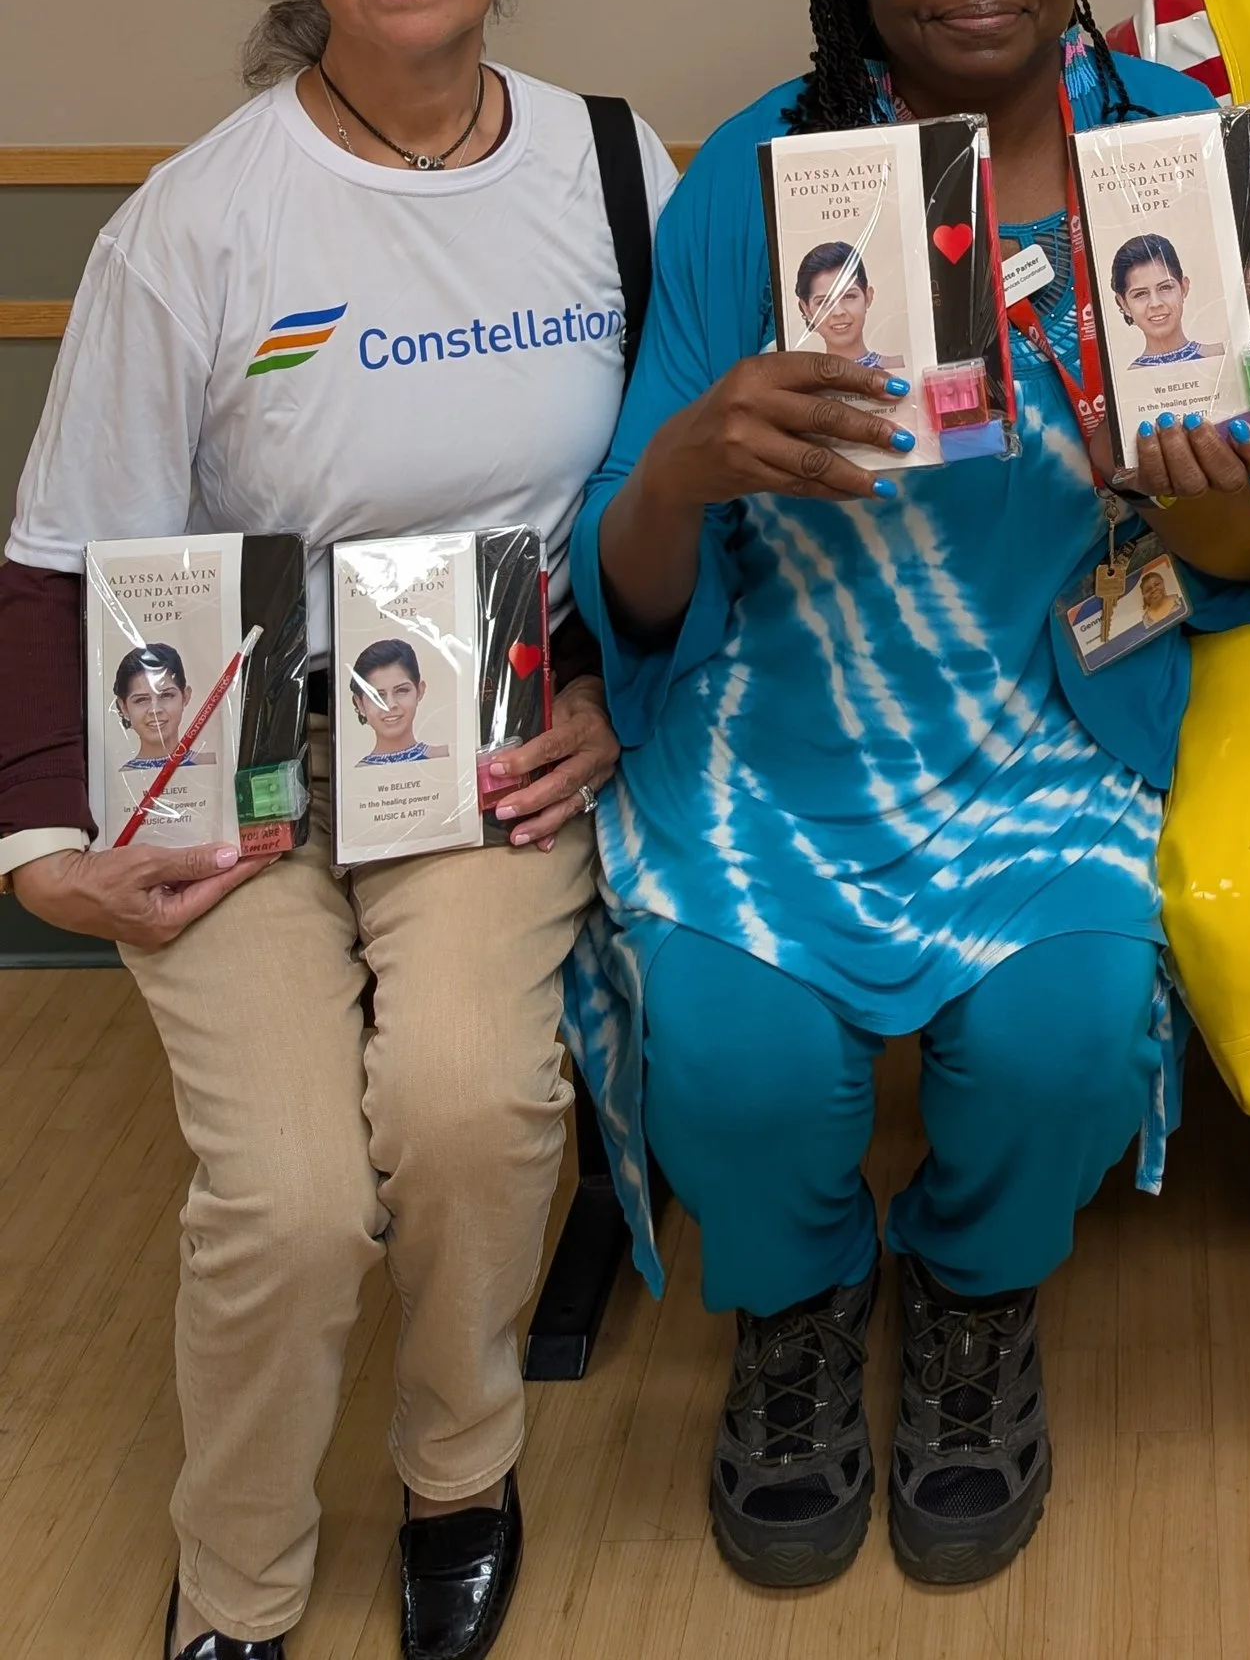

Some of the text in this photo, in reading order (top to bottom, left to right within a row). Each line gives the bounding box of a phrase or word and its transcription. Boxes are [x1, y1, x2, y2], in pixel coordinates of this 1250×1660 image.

[783, 162, 892, 183] ALYSSA ALVIN
[1090, 152, 1199, 179] ALYSSA ALVIN
[790, 178, 887, 197] FOUNDATION
[1097, 168, 1196, 193] FOUNDATION
[828, 195, 851, 205] FOR
[1137, 188, 1160, 198] FOR
[821, 207, 861, 220] HOPE
[1131, 199, 1171, 214] HOPE
[1015, 257, 1040, 275] Parker
[358, 303, 622, 371] Constellation
[1154, 380, 1200, 394] We BELIEVE
[889, 404, 897, 413] of
[1138, 392, 1221, 413] in the healing power of
[109, 568, 217, 586] ALYSSA ALVIN
[115, 583, 211, 599] FOUNDATION
[151, 600, 174, 609] FOR
[143, 611, 183, 623] HOPE
[161, 786, 188, 796] ELIEVE
[377, 780, 421, 793] We BELIEVE
[175, 801, 197, 809] power
[368, 800, 380, 808] the
[381, 797, 407, 807] healing
[408, 795, 430, 805] power
[431, 792, 440, 800] of
[373, 812, 399, 822] MUSIC
[400, 811, 406, 819] &
[241, 828, 280, 842] YOU ARE
[243, 839, 281, 854] smart
